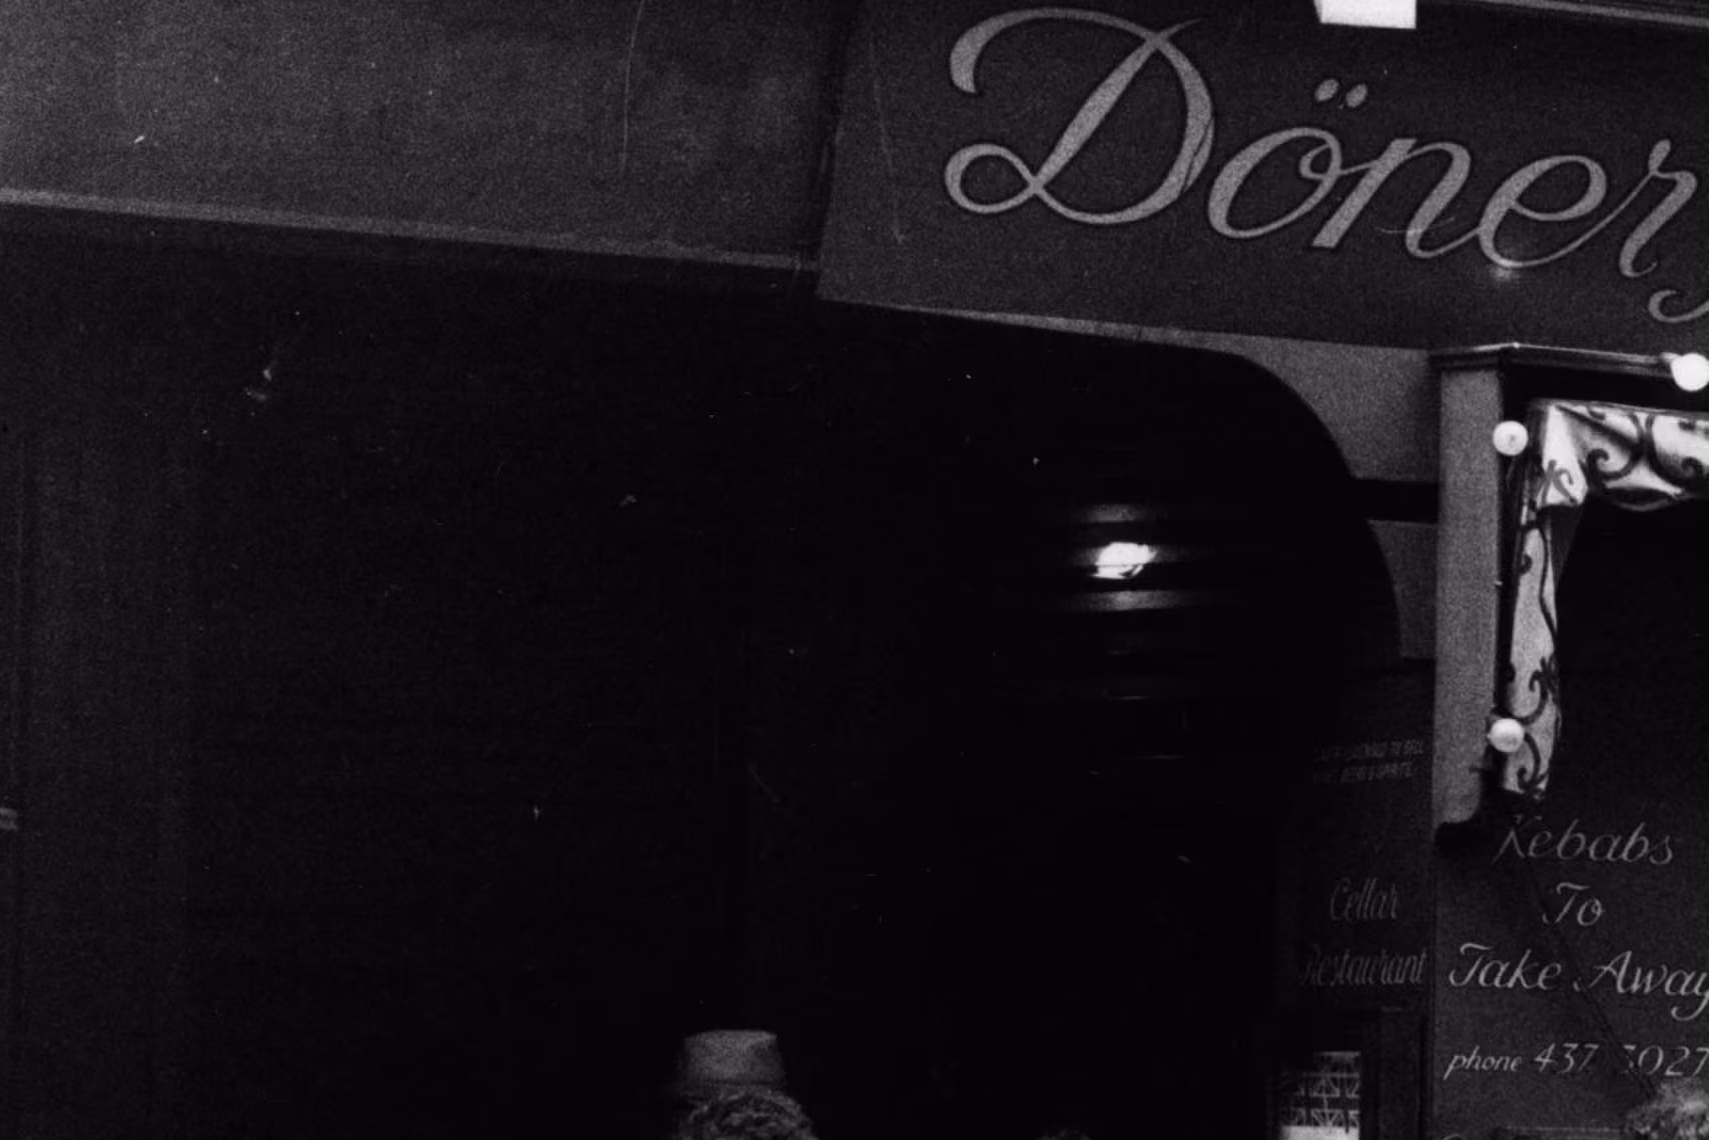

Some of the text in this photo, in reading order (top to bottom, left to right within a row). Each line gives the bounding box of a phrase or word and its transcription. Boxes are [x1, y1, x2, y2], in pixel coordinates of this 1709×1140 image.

[943, 7, 1697, 278] Döner
[1492, 814, 1675, 865] Kebabs
[1542, 882, 1604, 927] To
[1448, 942, 1563, 992] Take
[1443, 1044, 1523, 1080] phone
[1533, 1042, 1600, 1073] 437
